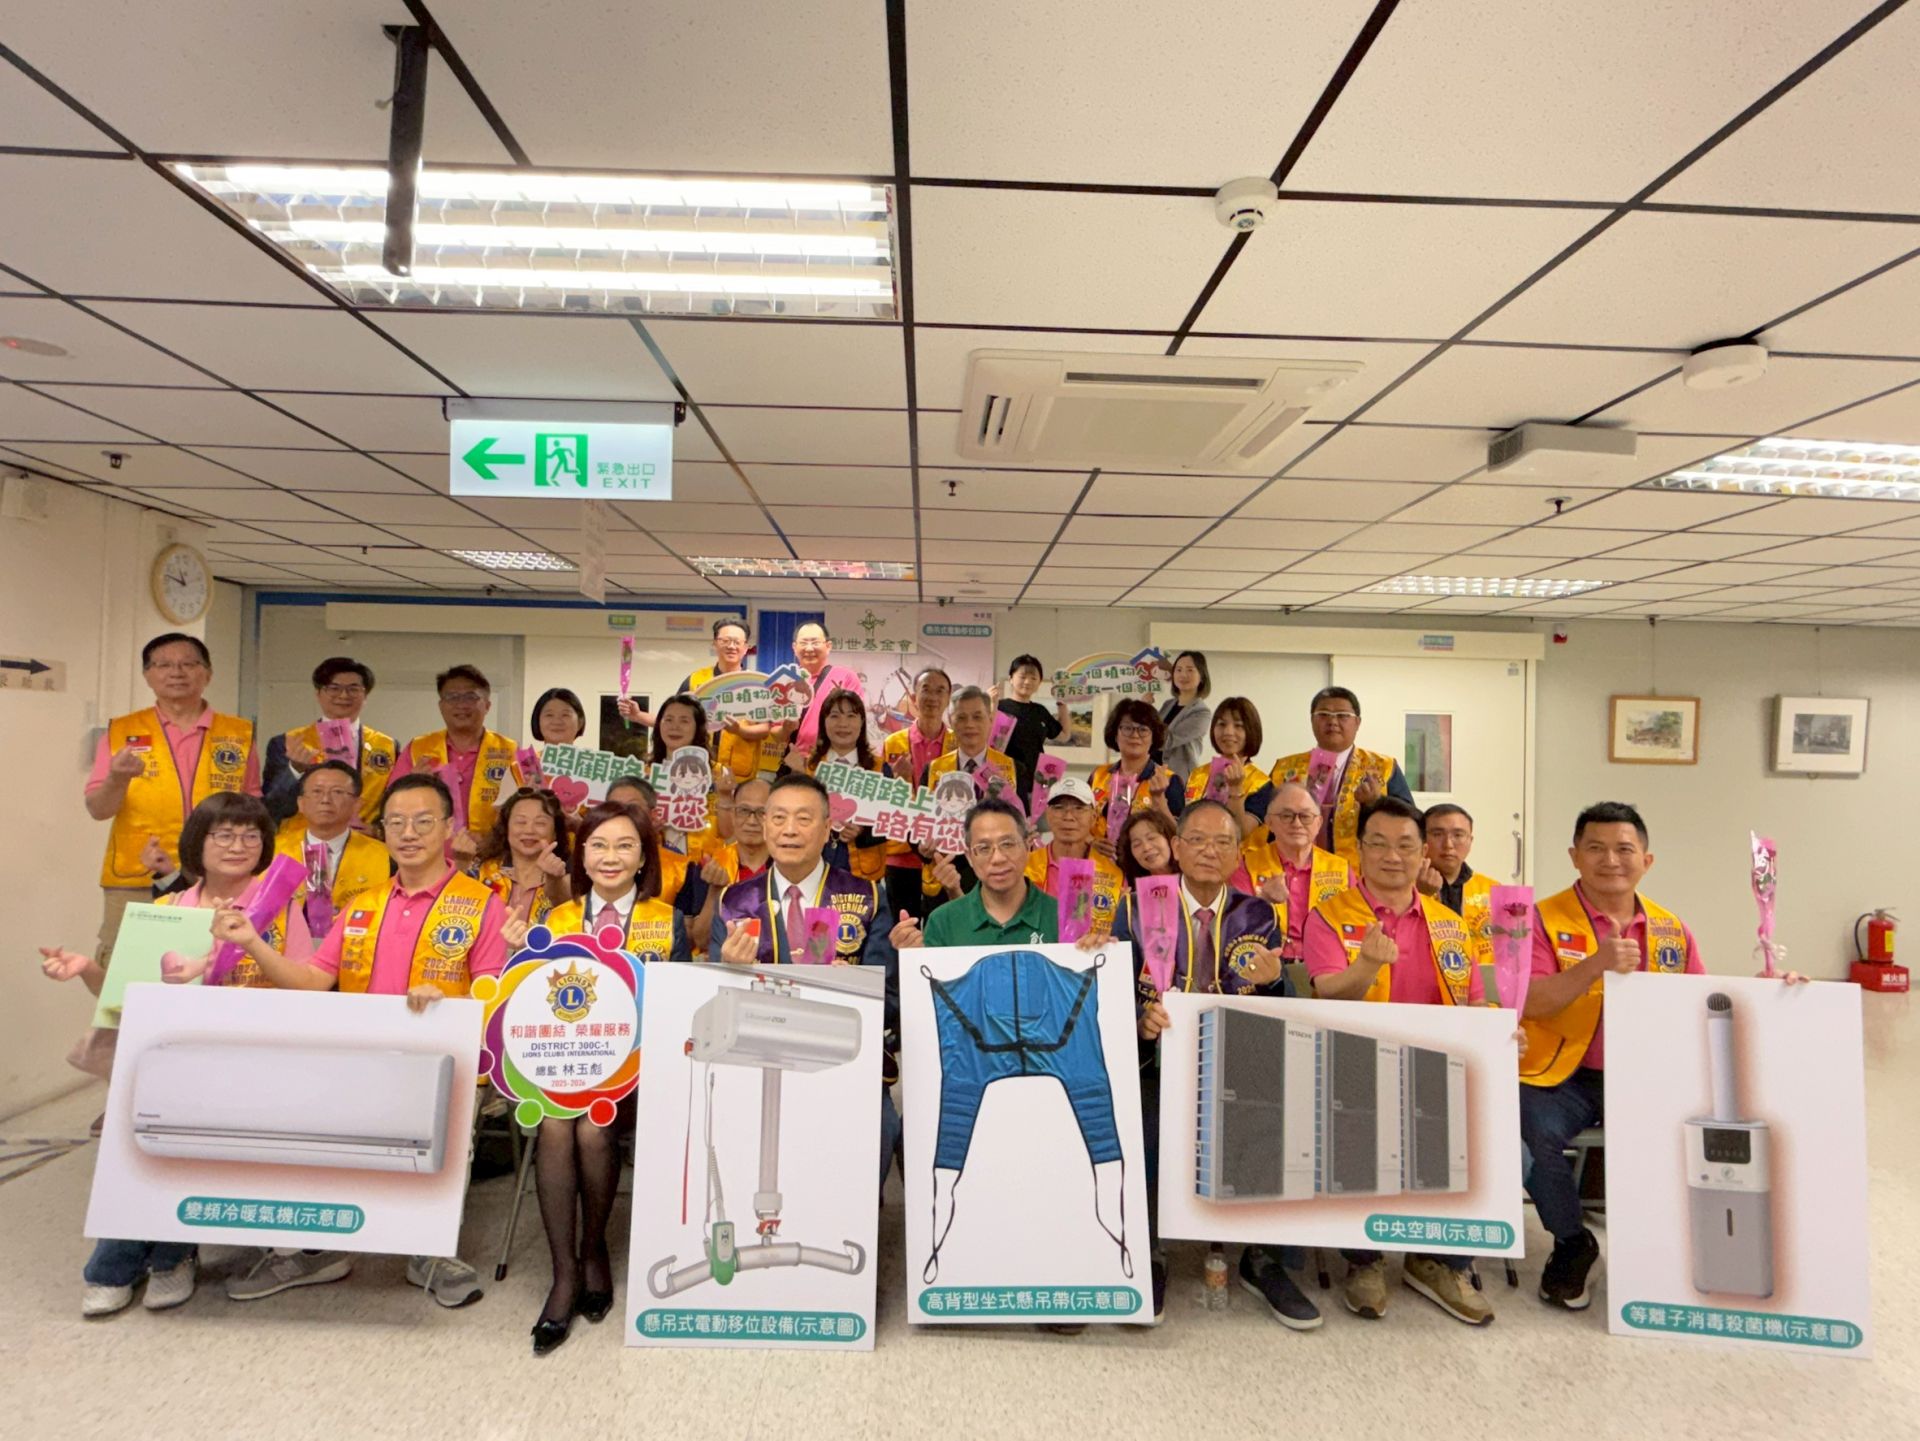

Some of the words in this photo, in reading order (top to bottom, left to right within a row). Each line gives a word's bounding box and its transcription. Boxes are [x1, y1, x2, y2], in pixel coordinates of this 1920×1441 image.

[597, 462, 656, 476] 緊急出口
[602, 478, 651, 489] EXIT
[816, 762, 934, 812] 照顧路上
[854, 810, 966, 850] 一路有您
[444, 895, 481, 907] CABINET
[831, 893, 866, 904] DISTRICT
[437, 904, 481, 919] SECRETARY
[558, 976, 587, 986] LIONS
[511, 1024, 566, 1038] 和諧團結
[576, 1023, 631, 1037] 榮耀服務
[531, 1042, 576, 1051] DISTRICT
[579, 1041, 610, 1050] 300C-1
[567, 1049, 616, 1057] INTERNATIONAL
[536, 1065, 557, 1076] 總監
[562, 1062, 603, 1076] 林玉彪
[551, 1079, 586, 1087] 2025-2026
[183, 1201, 360, 1229] 變頻冷暖氣機(示意圖)
[1372, 1219, 1508, 1245] 中央空調(示意圖)
[926, 1291, 1136, 1311] 高背型坐式懸吊帶(示意圖)
[644, 1313, 861, 1337] 懸吊式電動移位設備(示意圖)
[1629, 1305, 1856, 1345] 等離子消毒殺菌機(示意圖)
